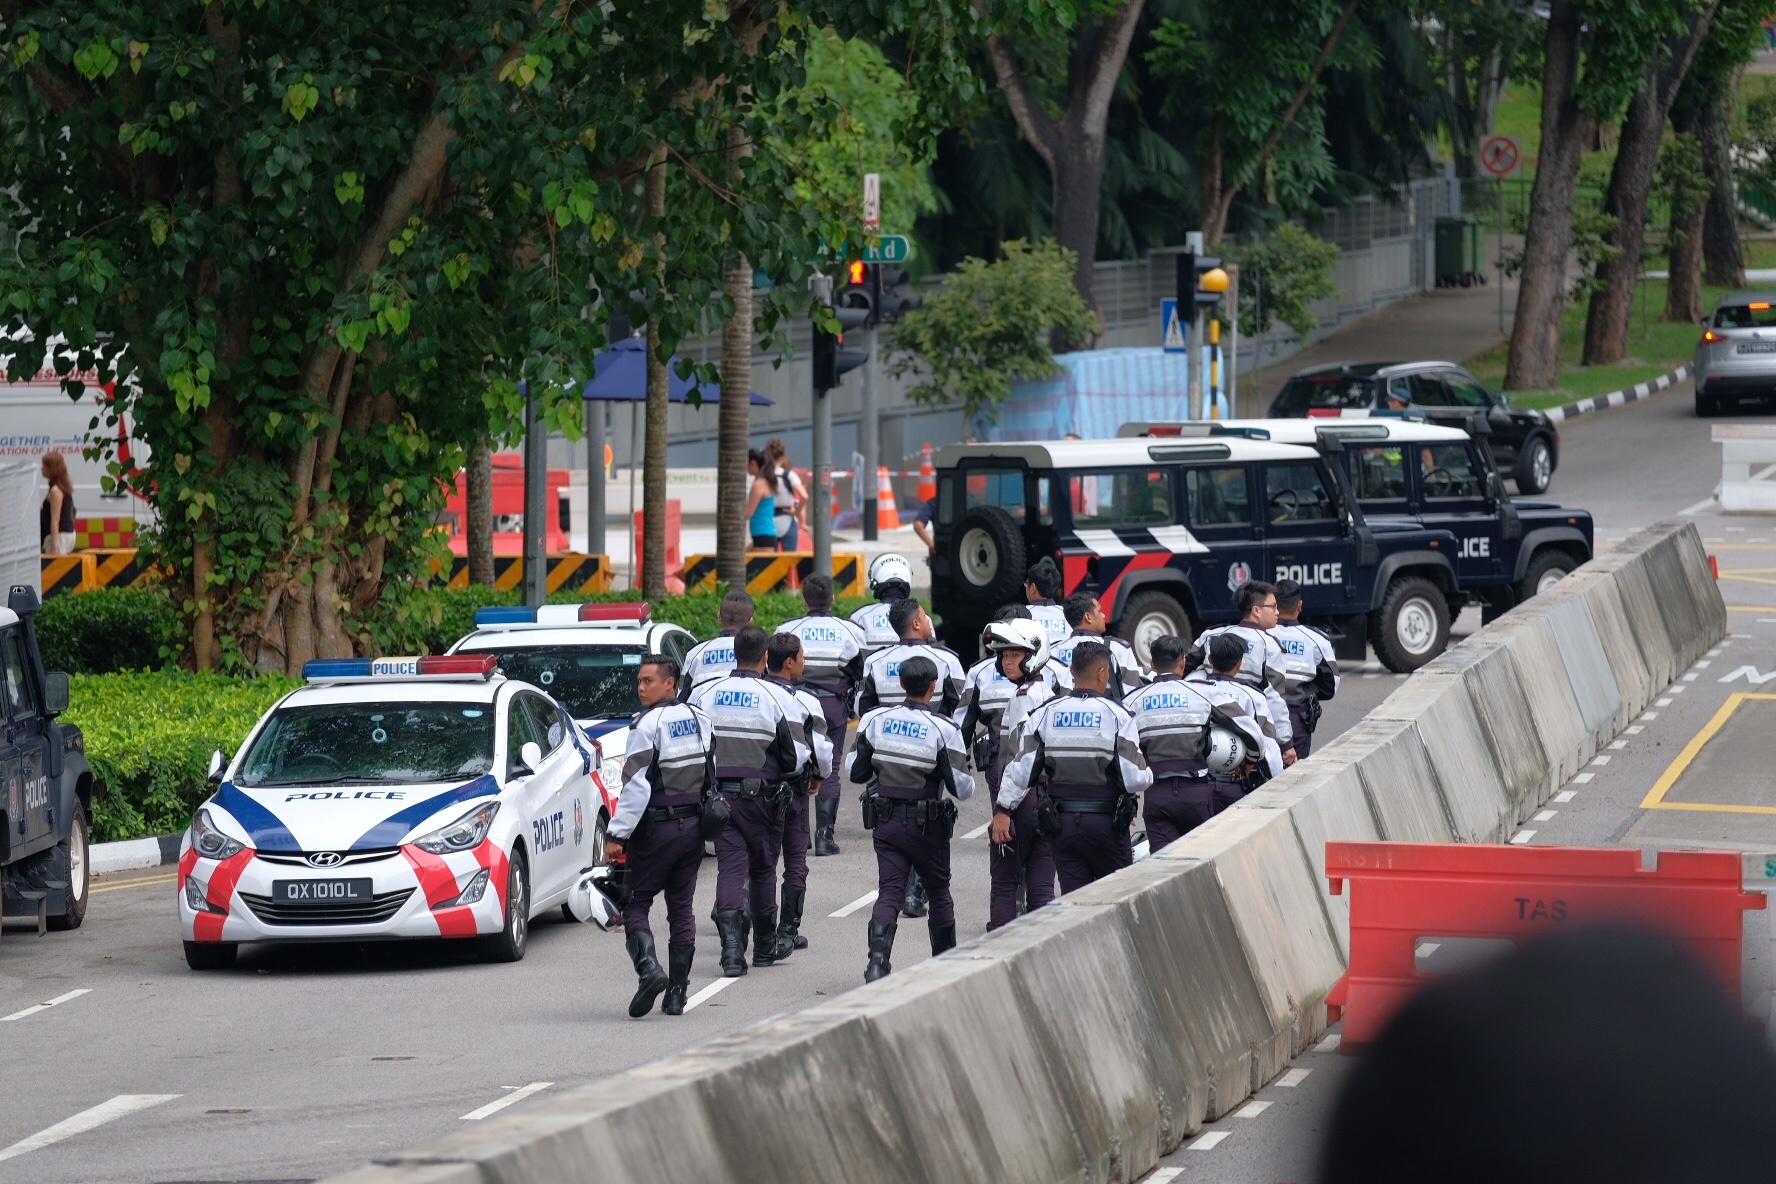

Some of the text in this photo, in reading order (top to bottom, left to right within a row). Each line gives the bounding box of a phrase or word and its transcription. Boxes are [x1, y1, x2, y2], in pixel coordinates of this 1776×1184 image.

[31, 445, 44, 455] OF
[880, 557, 907, 567] POLICE
[1276, 562, 1342, 586] POLICE
[802, 628, 841, 642] POLICE
[704, 649, 737, 664] POLIC
[373, 662, 415, 675] POLICE
[715, 691, 760, 708] POLICE
[1143, 694, 1189, 710] POLICE
[1053, 712, 1101, 728] POLICE
[669, 719, 698, 738] POLIC
[884, 718, 928, 739] POLICE
[1221, 737, 1238, 768] POLICE
[25, 775, 48, 811] POLICE
[285, 791, 407, 802] POLICE
[533, 811, 565, 855] POLICE
[1514, 897, 1568, 922] TAS
